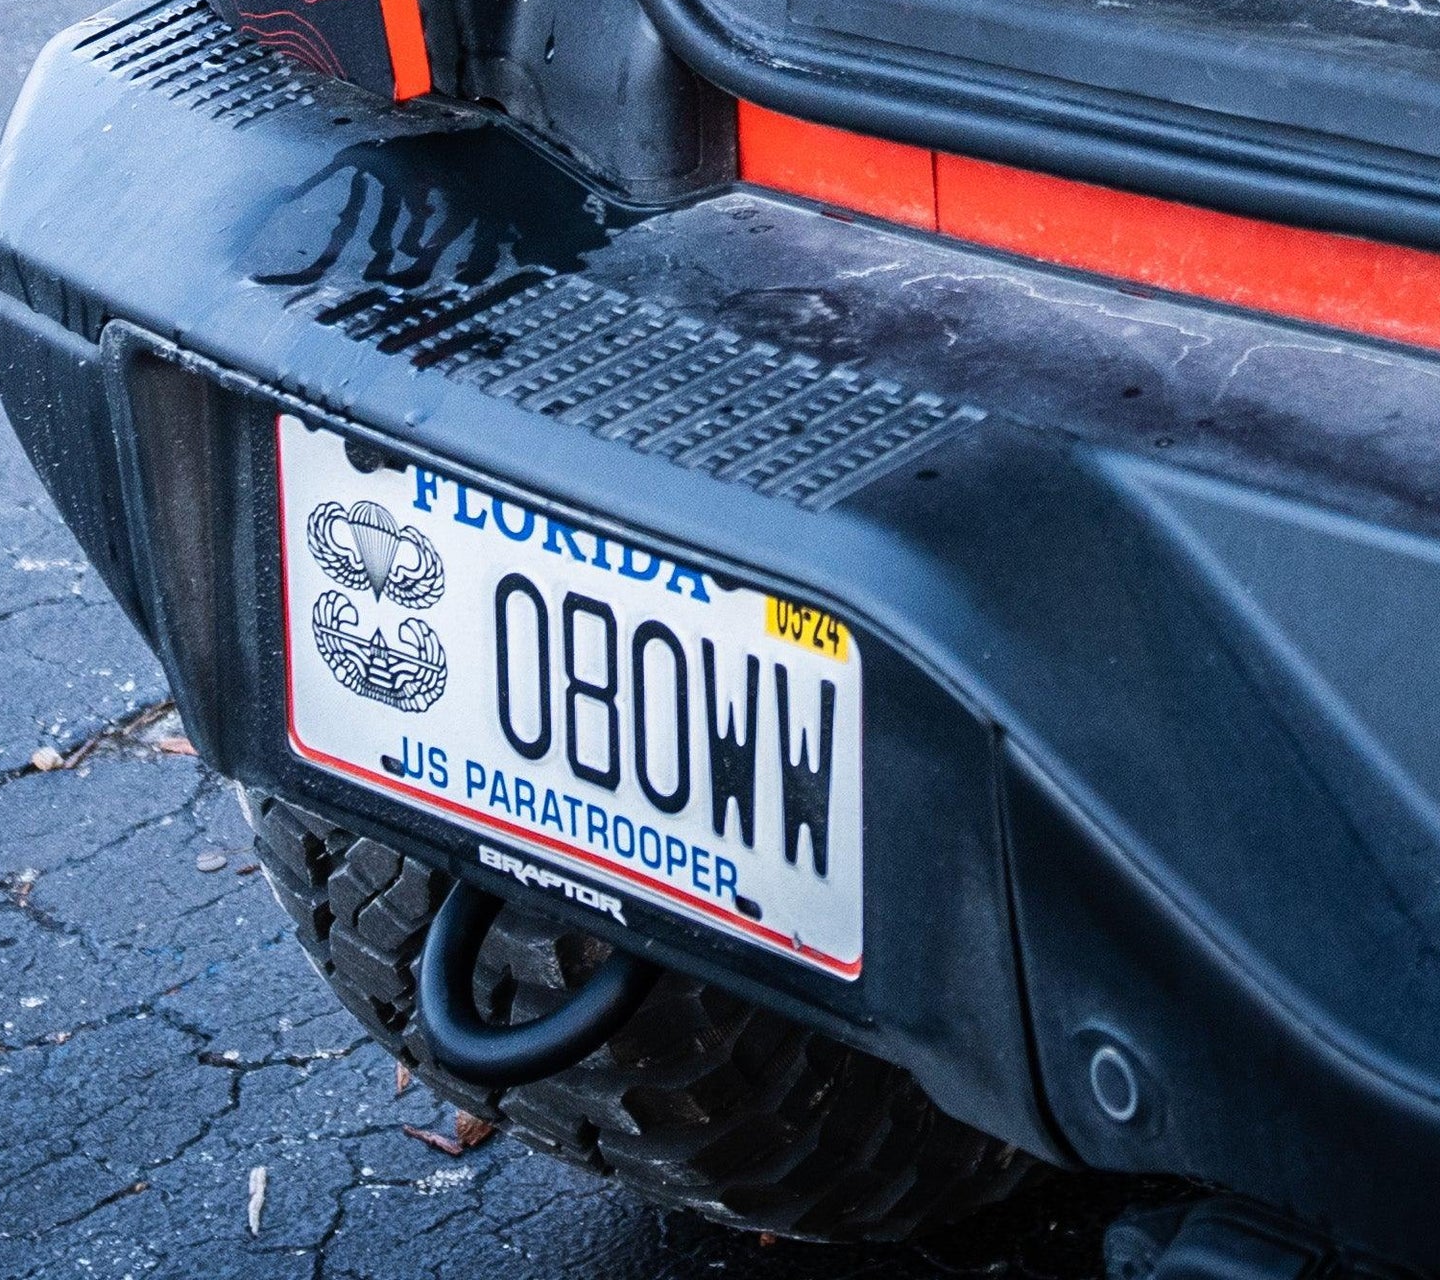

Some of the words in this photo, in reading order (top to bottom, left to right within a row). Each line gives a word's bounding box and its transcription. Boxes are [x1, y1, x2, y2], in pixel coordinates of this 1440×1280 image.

[402, 736, 449, 788] US
[465, 759, 738, 901] PARATROOPER
[478, 844, 628, 927] BRAPTOR
